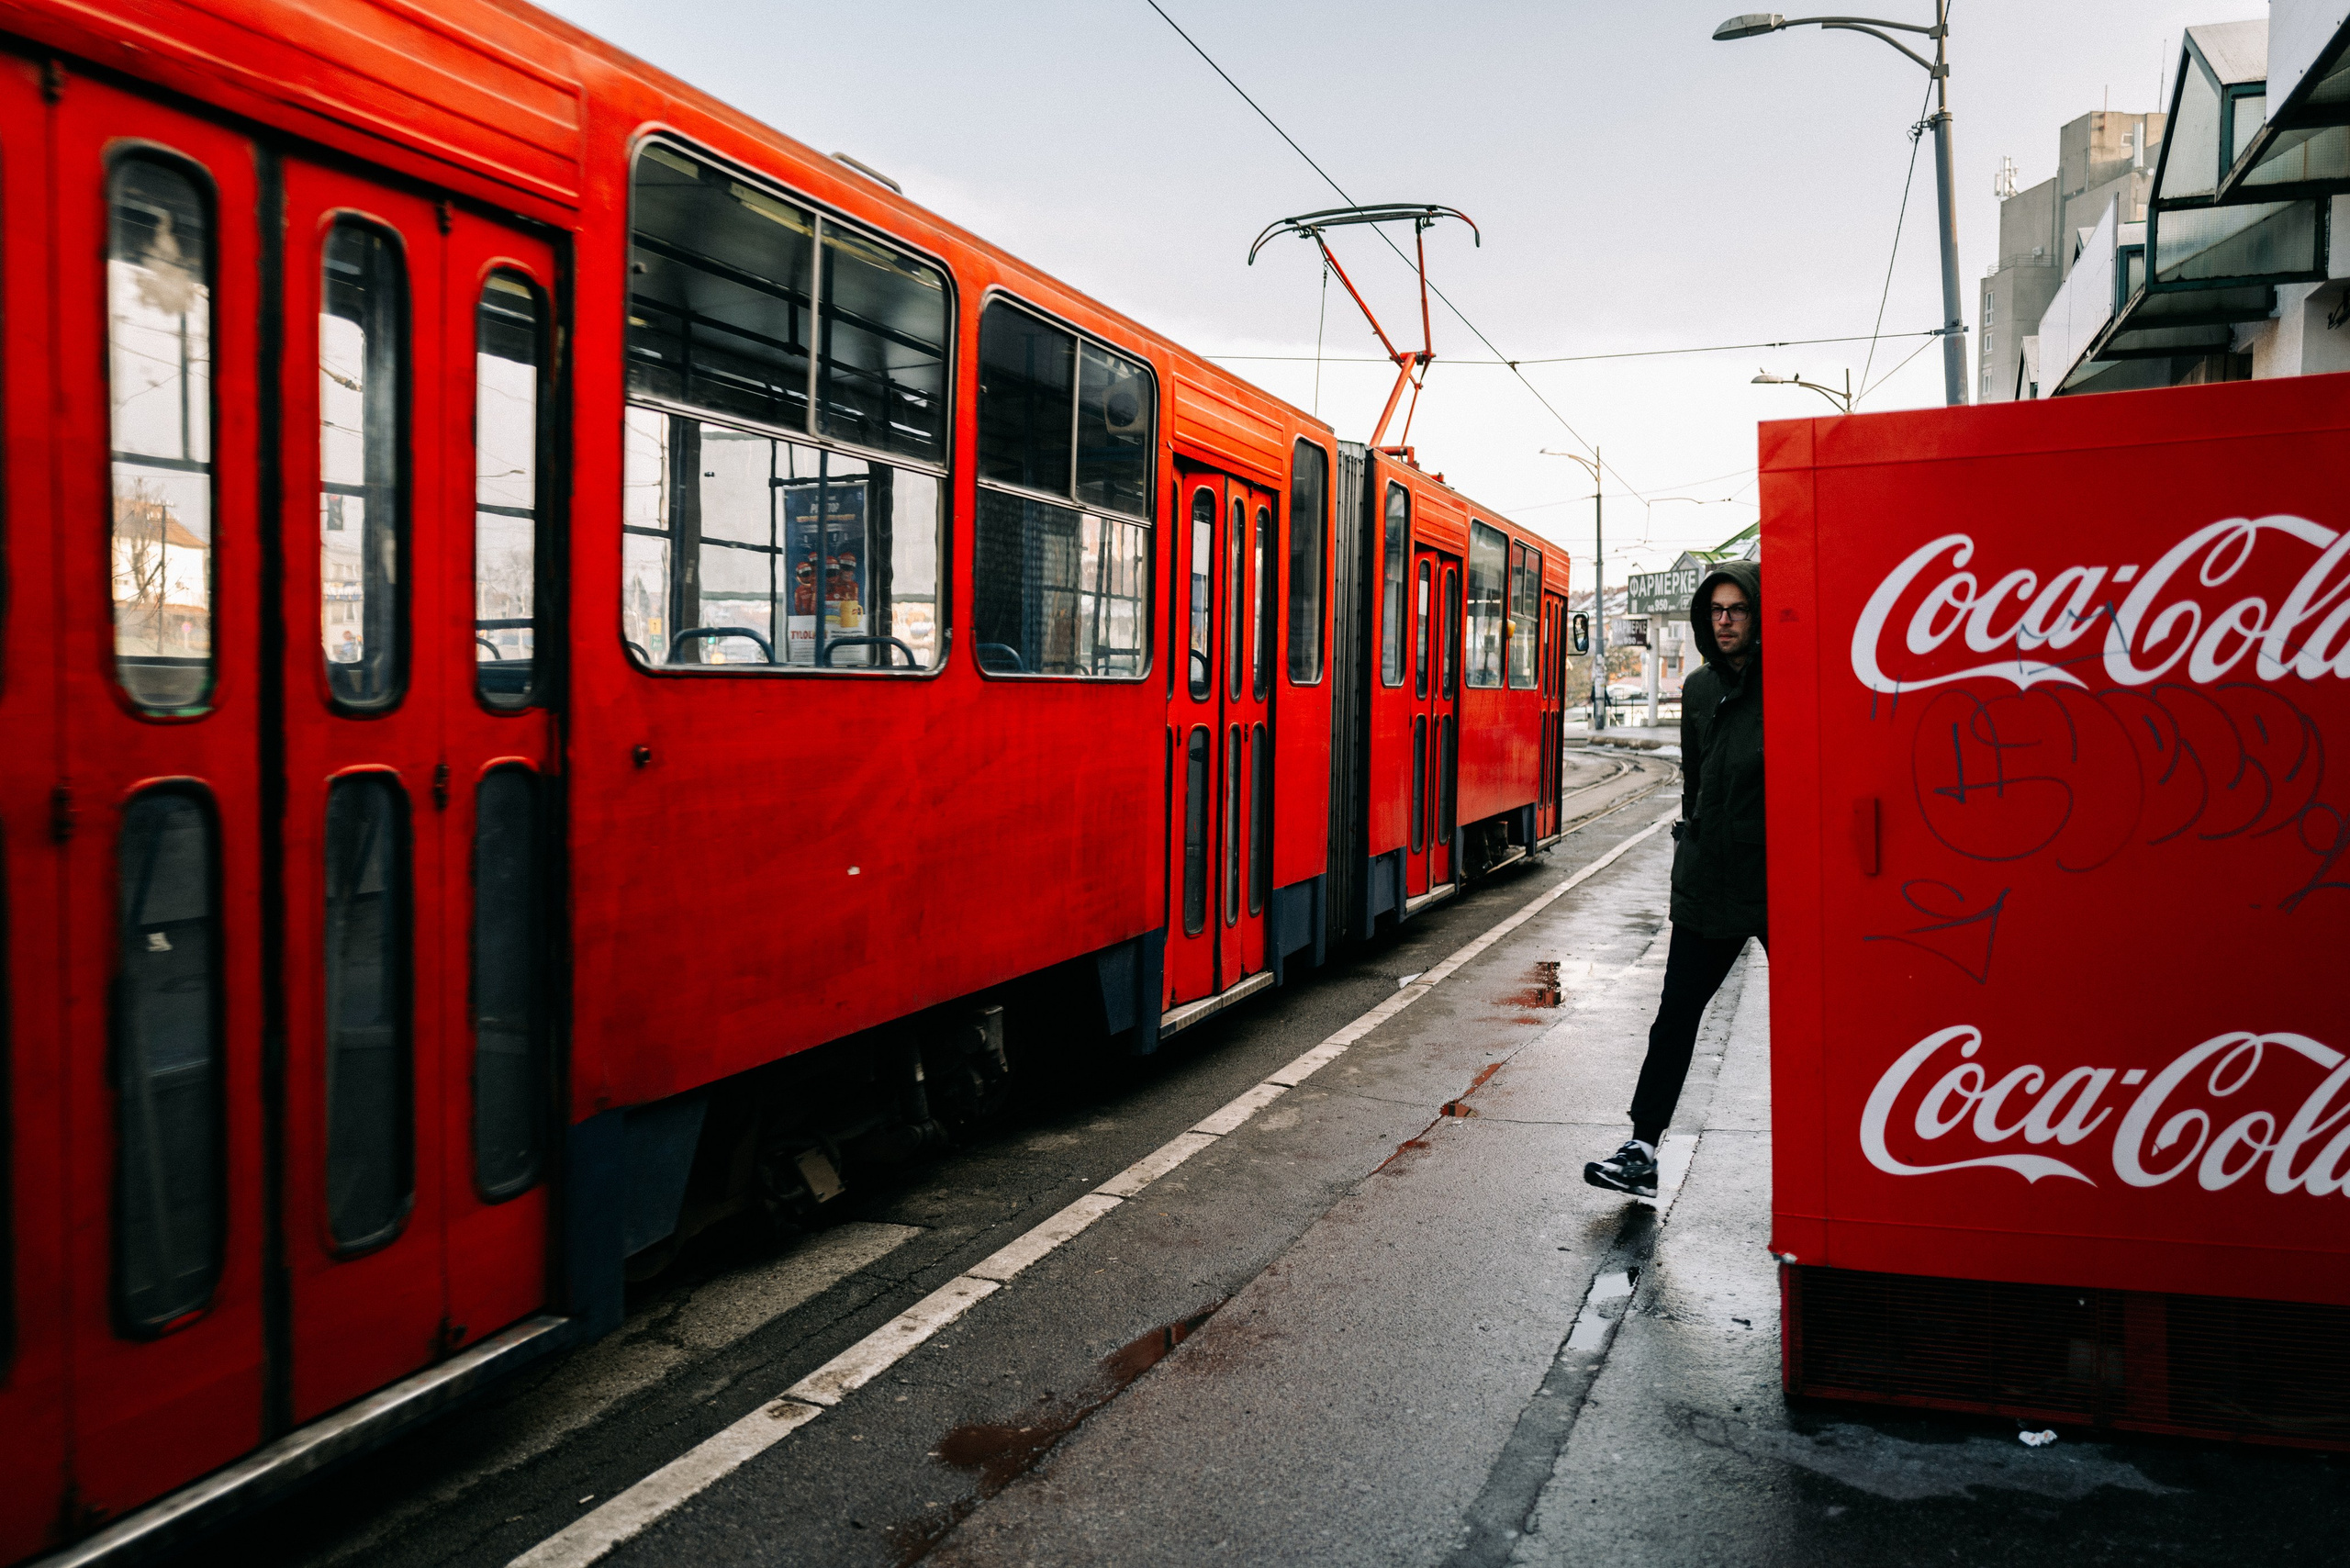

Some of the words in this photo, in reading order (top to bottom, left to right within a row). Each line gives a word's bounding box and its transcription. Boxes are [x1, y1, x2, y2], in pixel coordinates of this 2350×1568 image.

[1629, 570, 1696, 598] ФАРМЕРКЕ
[1654, 599, 1668, 611] 950
[1851, 514, 2350, 693] Coca-Cola
[1859, 1024, 2350, 1197] Coca-Cola
